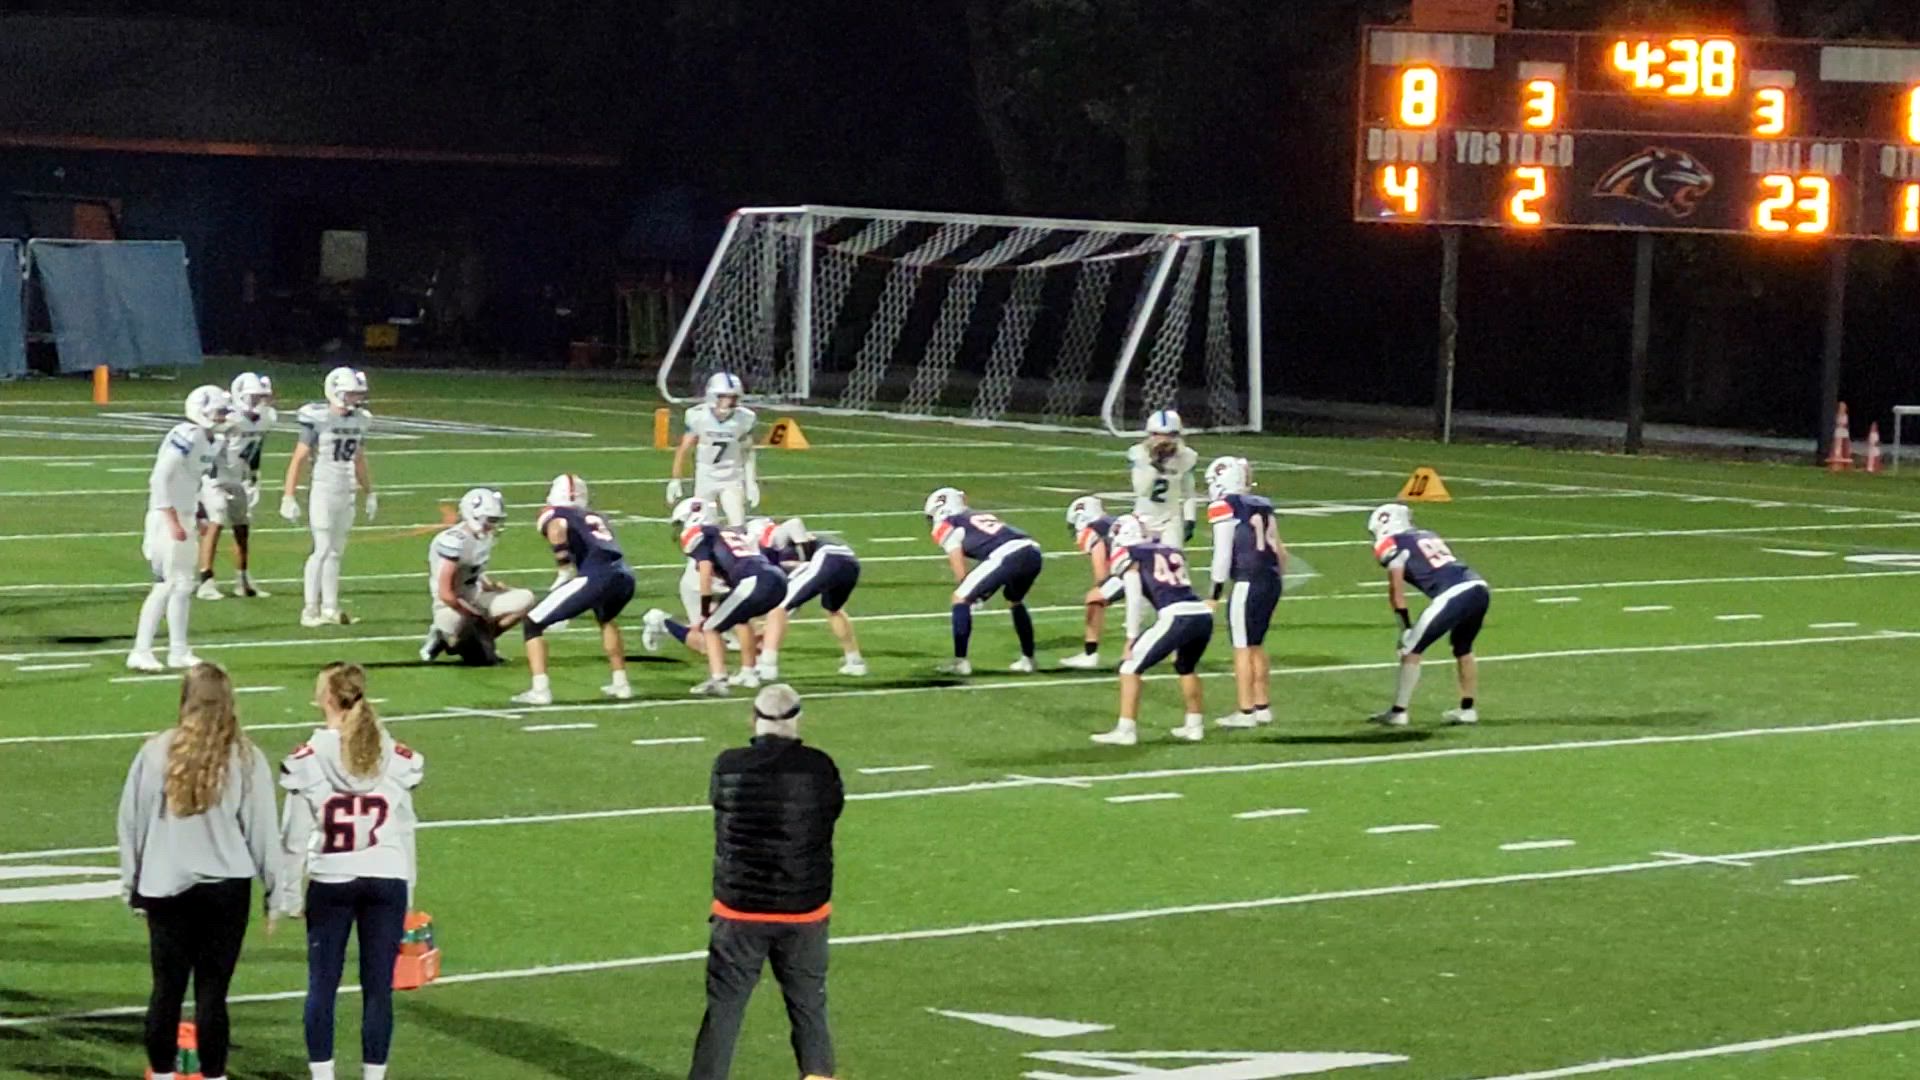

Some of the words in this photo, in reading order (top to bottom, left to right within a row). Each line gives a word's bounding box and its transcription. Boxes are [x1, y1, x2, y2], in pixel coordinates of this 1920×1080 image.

[1613, 38, 1736, 97] 4:38
[1400, 67, 1438, 127] 8
[1525, 80, 1556, 128] 3
[1755, 88, 1785, 135] 3
[1455, 131, 1501, 165] YDS
[1507, 133, 1537, 165] TO
[1384, 164, 1418, 213] 4
[1511, 166, 1546, 224] 2
[1757, 174, 1830, 233] 23
[712, 441, 729, 464] 7
[1151, 479, 1170, 502] 2
[322, 794, 389, 854] 67
